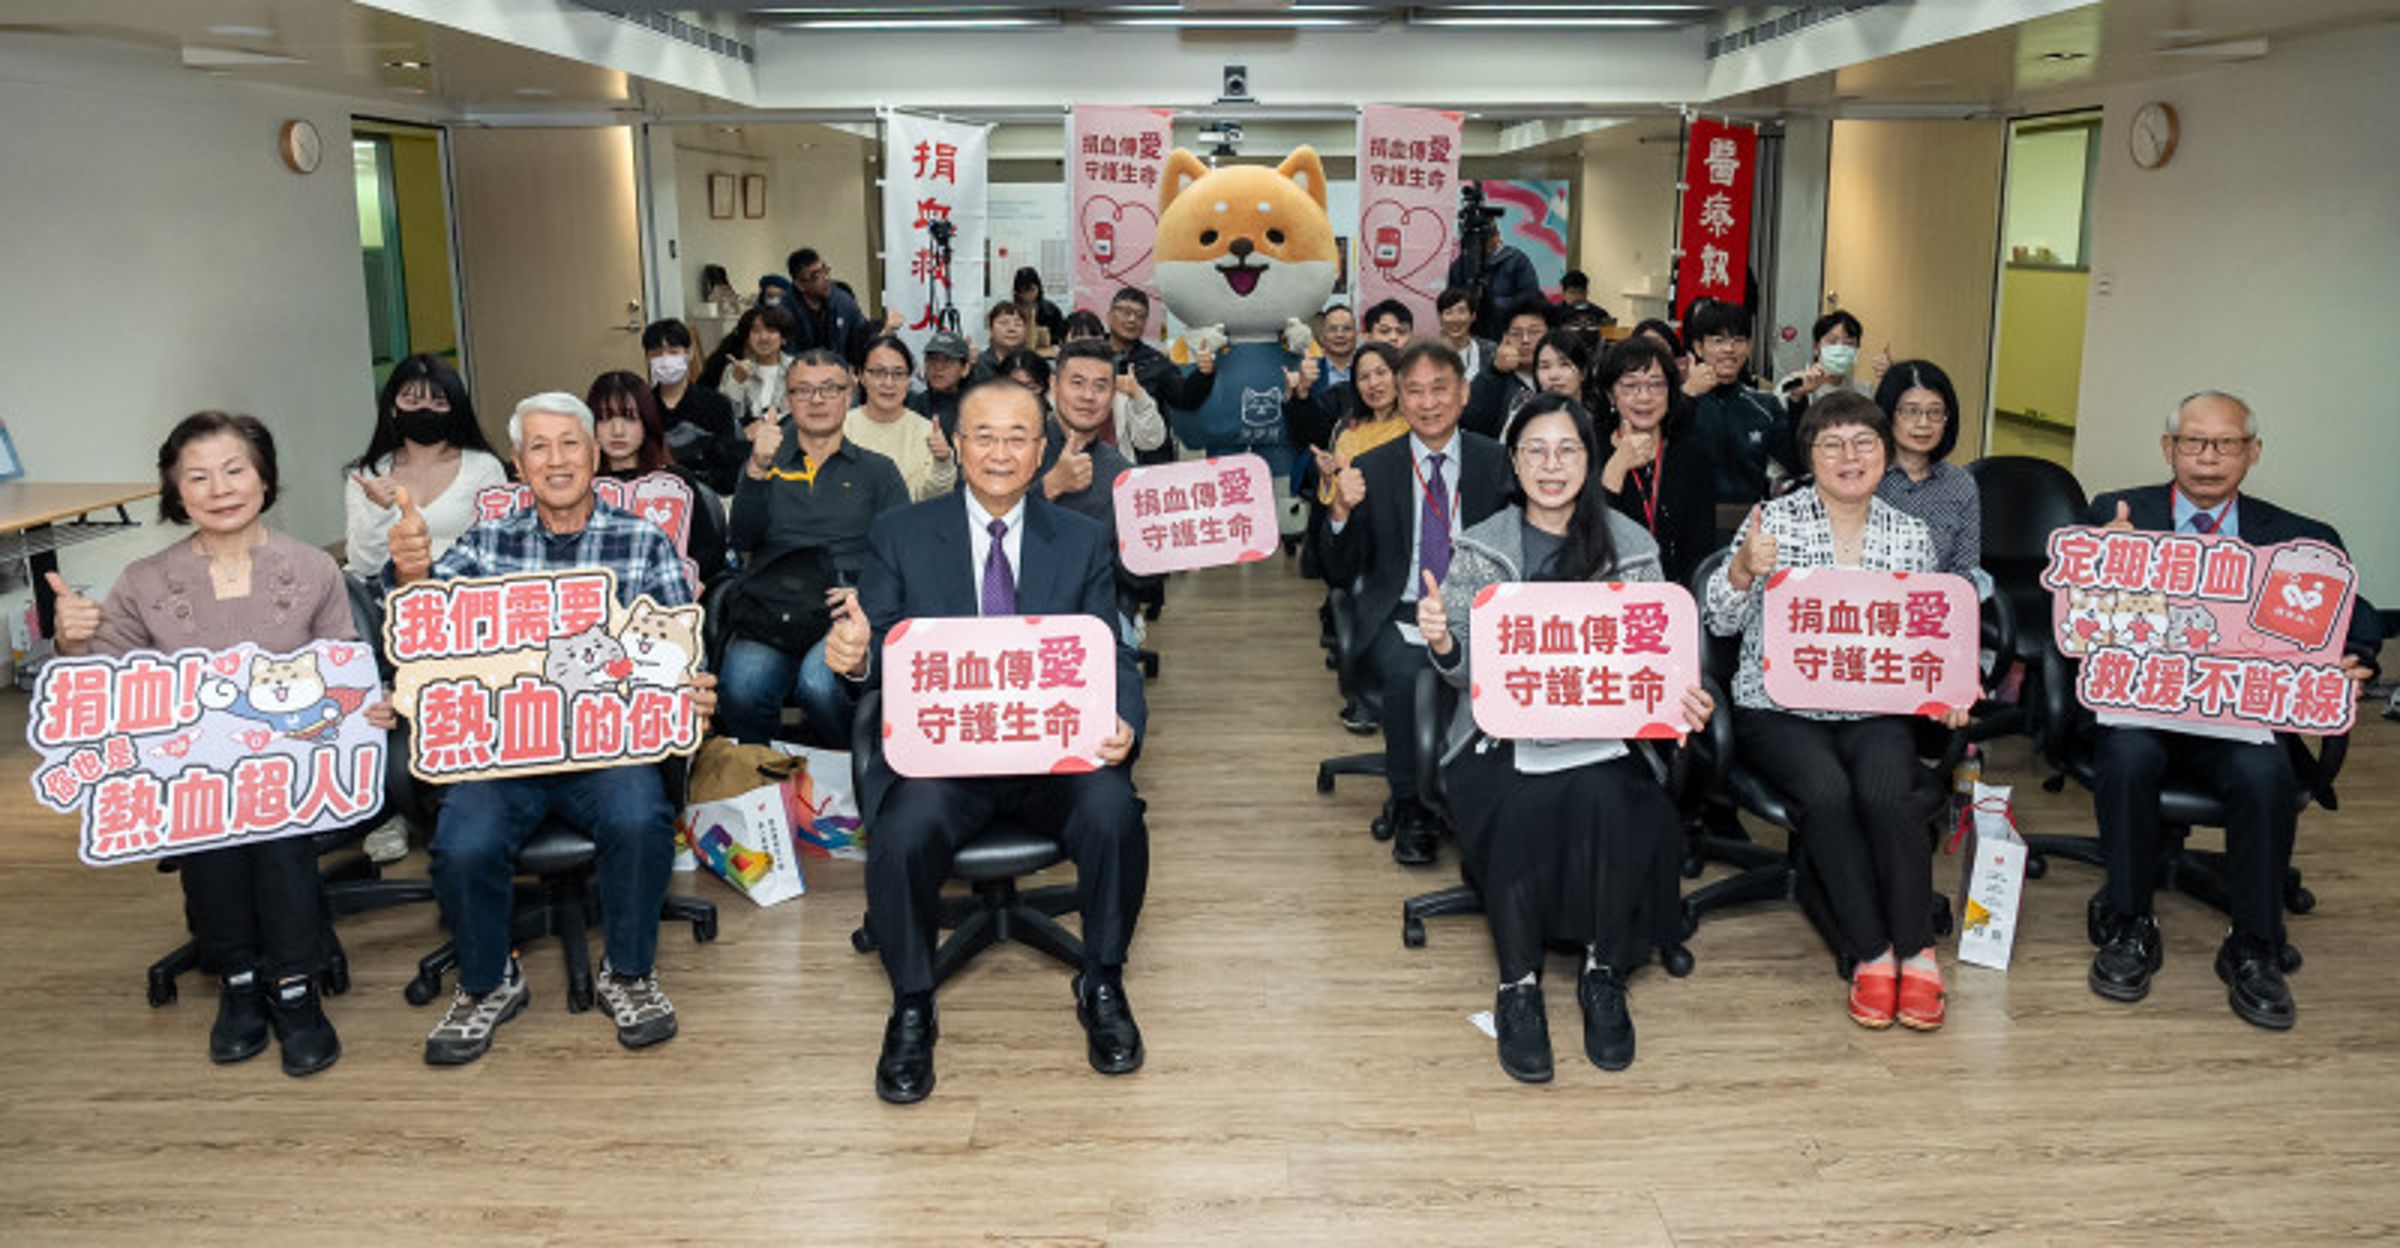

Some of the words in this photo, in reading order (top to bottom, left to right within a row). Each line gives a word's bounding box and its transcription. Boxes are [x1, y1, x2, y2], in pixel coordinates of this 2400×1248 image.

[1082, 132, 1162, 159] 捐血傳愛
[1370, 136, 1452, 163] 捐血傳愛
[1699, 137, 1742, 300] 醫療報
[1133, 467, 1255, 518] 捐血傳愛
[1141, 513, 1254, 551] 守護生命
[2055, 535, 2246, 596] 定期捐血
[398, 579, 604, 655] 我們需要
[1497, 601, 1671, 655] 捐血傳愛
[1787, 590, 1951, 639] 捐血傳愛
[911, 635, 1087, 693] 捐血傳愛
[1504, 665, 1666, 714] 守護生命
[1793, 644, 1945, 694] 守護生命
[2087, 652, 2348, 724] 救援不斷線
[43, 658, 200, 740] 捐血!
[420, 680, 692, 769] 熱血的你!
[917, 700, 1080, 748] 守護生命
[45, 736, 135, 801] 你也是
[94, 746, 375, 853] 熱血超人!
